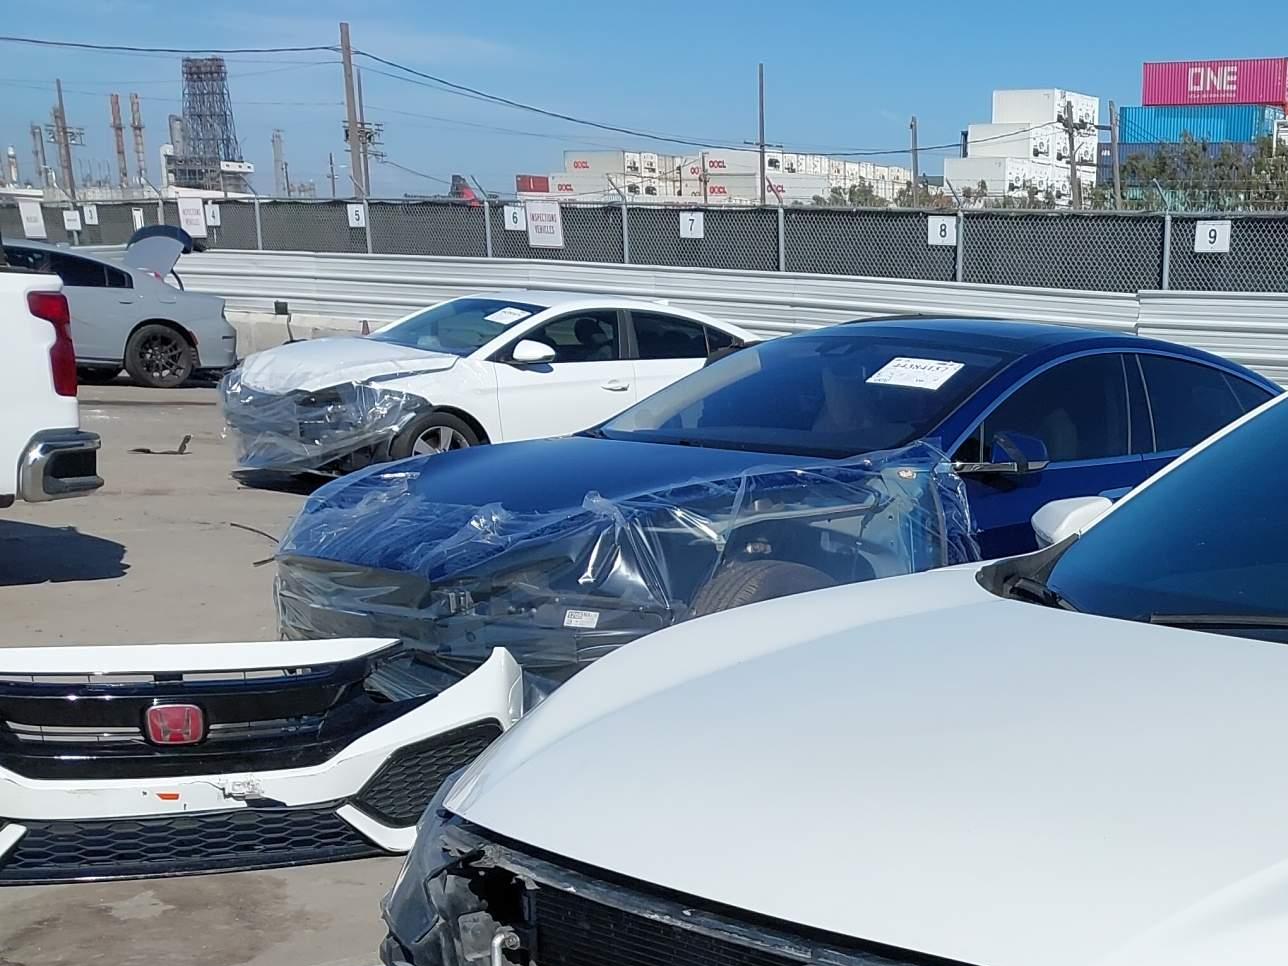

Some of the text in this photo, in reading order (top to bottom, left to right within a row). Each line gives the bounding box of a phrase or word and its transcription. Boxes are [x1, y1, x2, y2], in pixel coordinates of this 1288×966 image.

[1188, 65, 1238, 92] ONE
[573, 160, 589, 169] OOCL
[709, 159, 727, 169] OOCL
[709, 185, 727, 194] OOCL
[354, 209, 361, 222] 5
[512, 211, 519, 225] 6
[688, 218, 695, 231] 7
[939, 223, 947, 238] 8
[1208, 228, 1217, 245] 9
